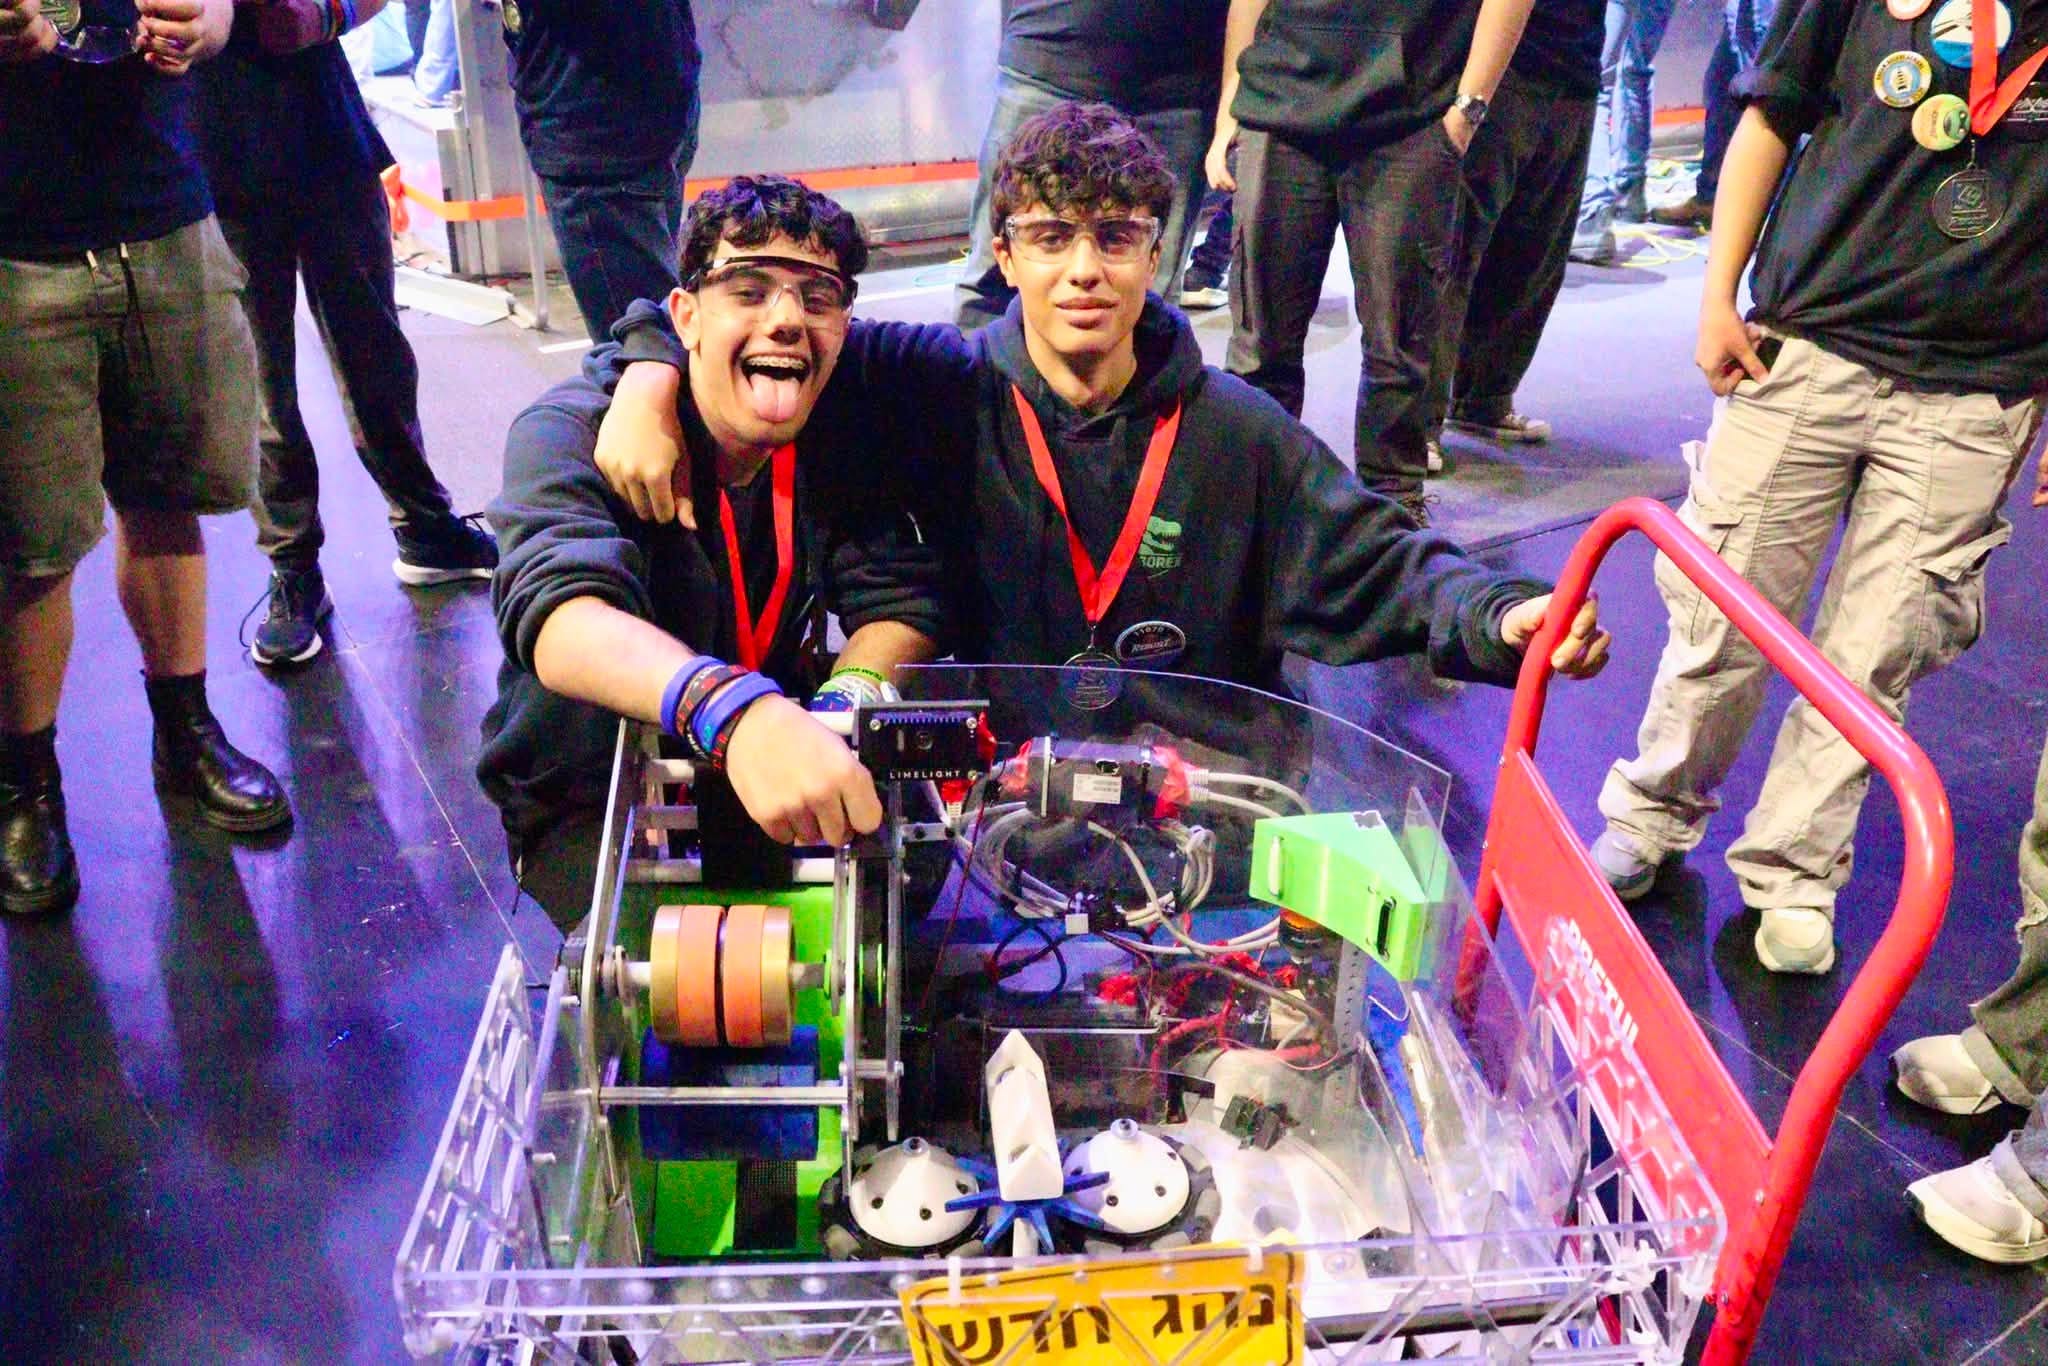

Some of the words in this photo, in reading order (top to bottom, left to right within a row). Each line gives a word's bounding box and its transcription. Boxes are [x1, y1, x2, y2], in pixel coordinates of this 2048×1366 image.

[889, 770, 961, 779] LIMELIGHT
[939, 1306, 1110, 1366] חדש
[1152, 1284, 1275, 1338] נהג
